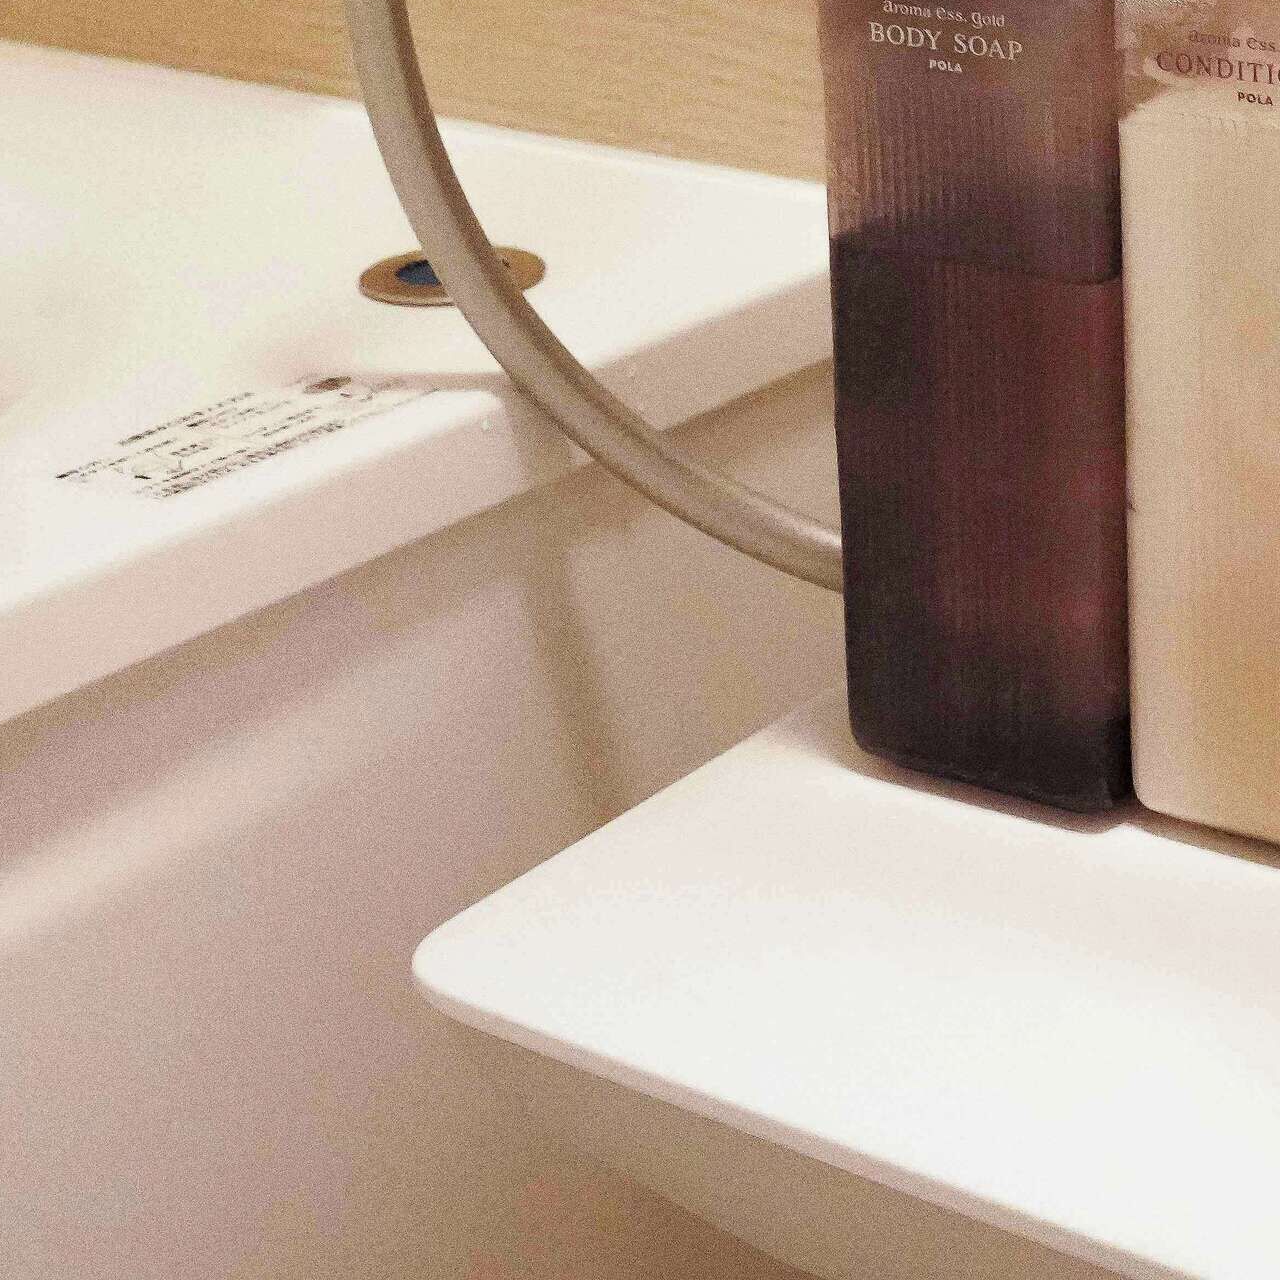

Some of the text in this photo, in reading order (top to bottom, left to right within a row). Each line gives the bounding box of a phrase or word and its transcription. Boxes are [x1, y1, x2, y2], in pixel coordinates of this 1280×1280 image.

[882, 0, 932, 19] aroma
[971, 10, 1006, 30] gold
[869, 21, 1023, 61] BODY SOAP
[1188, 29, 1242, 49] aroma
[928, 58, 963, 73] POLA
[1237, 90, 1274, 107] POLA
